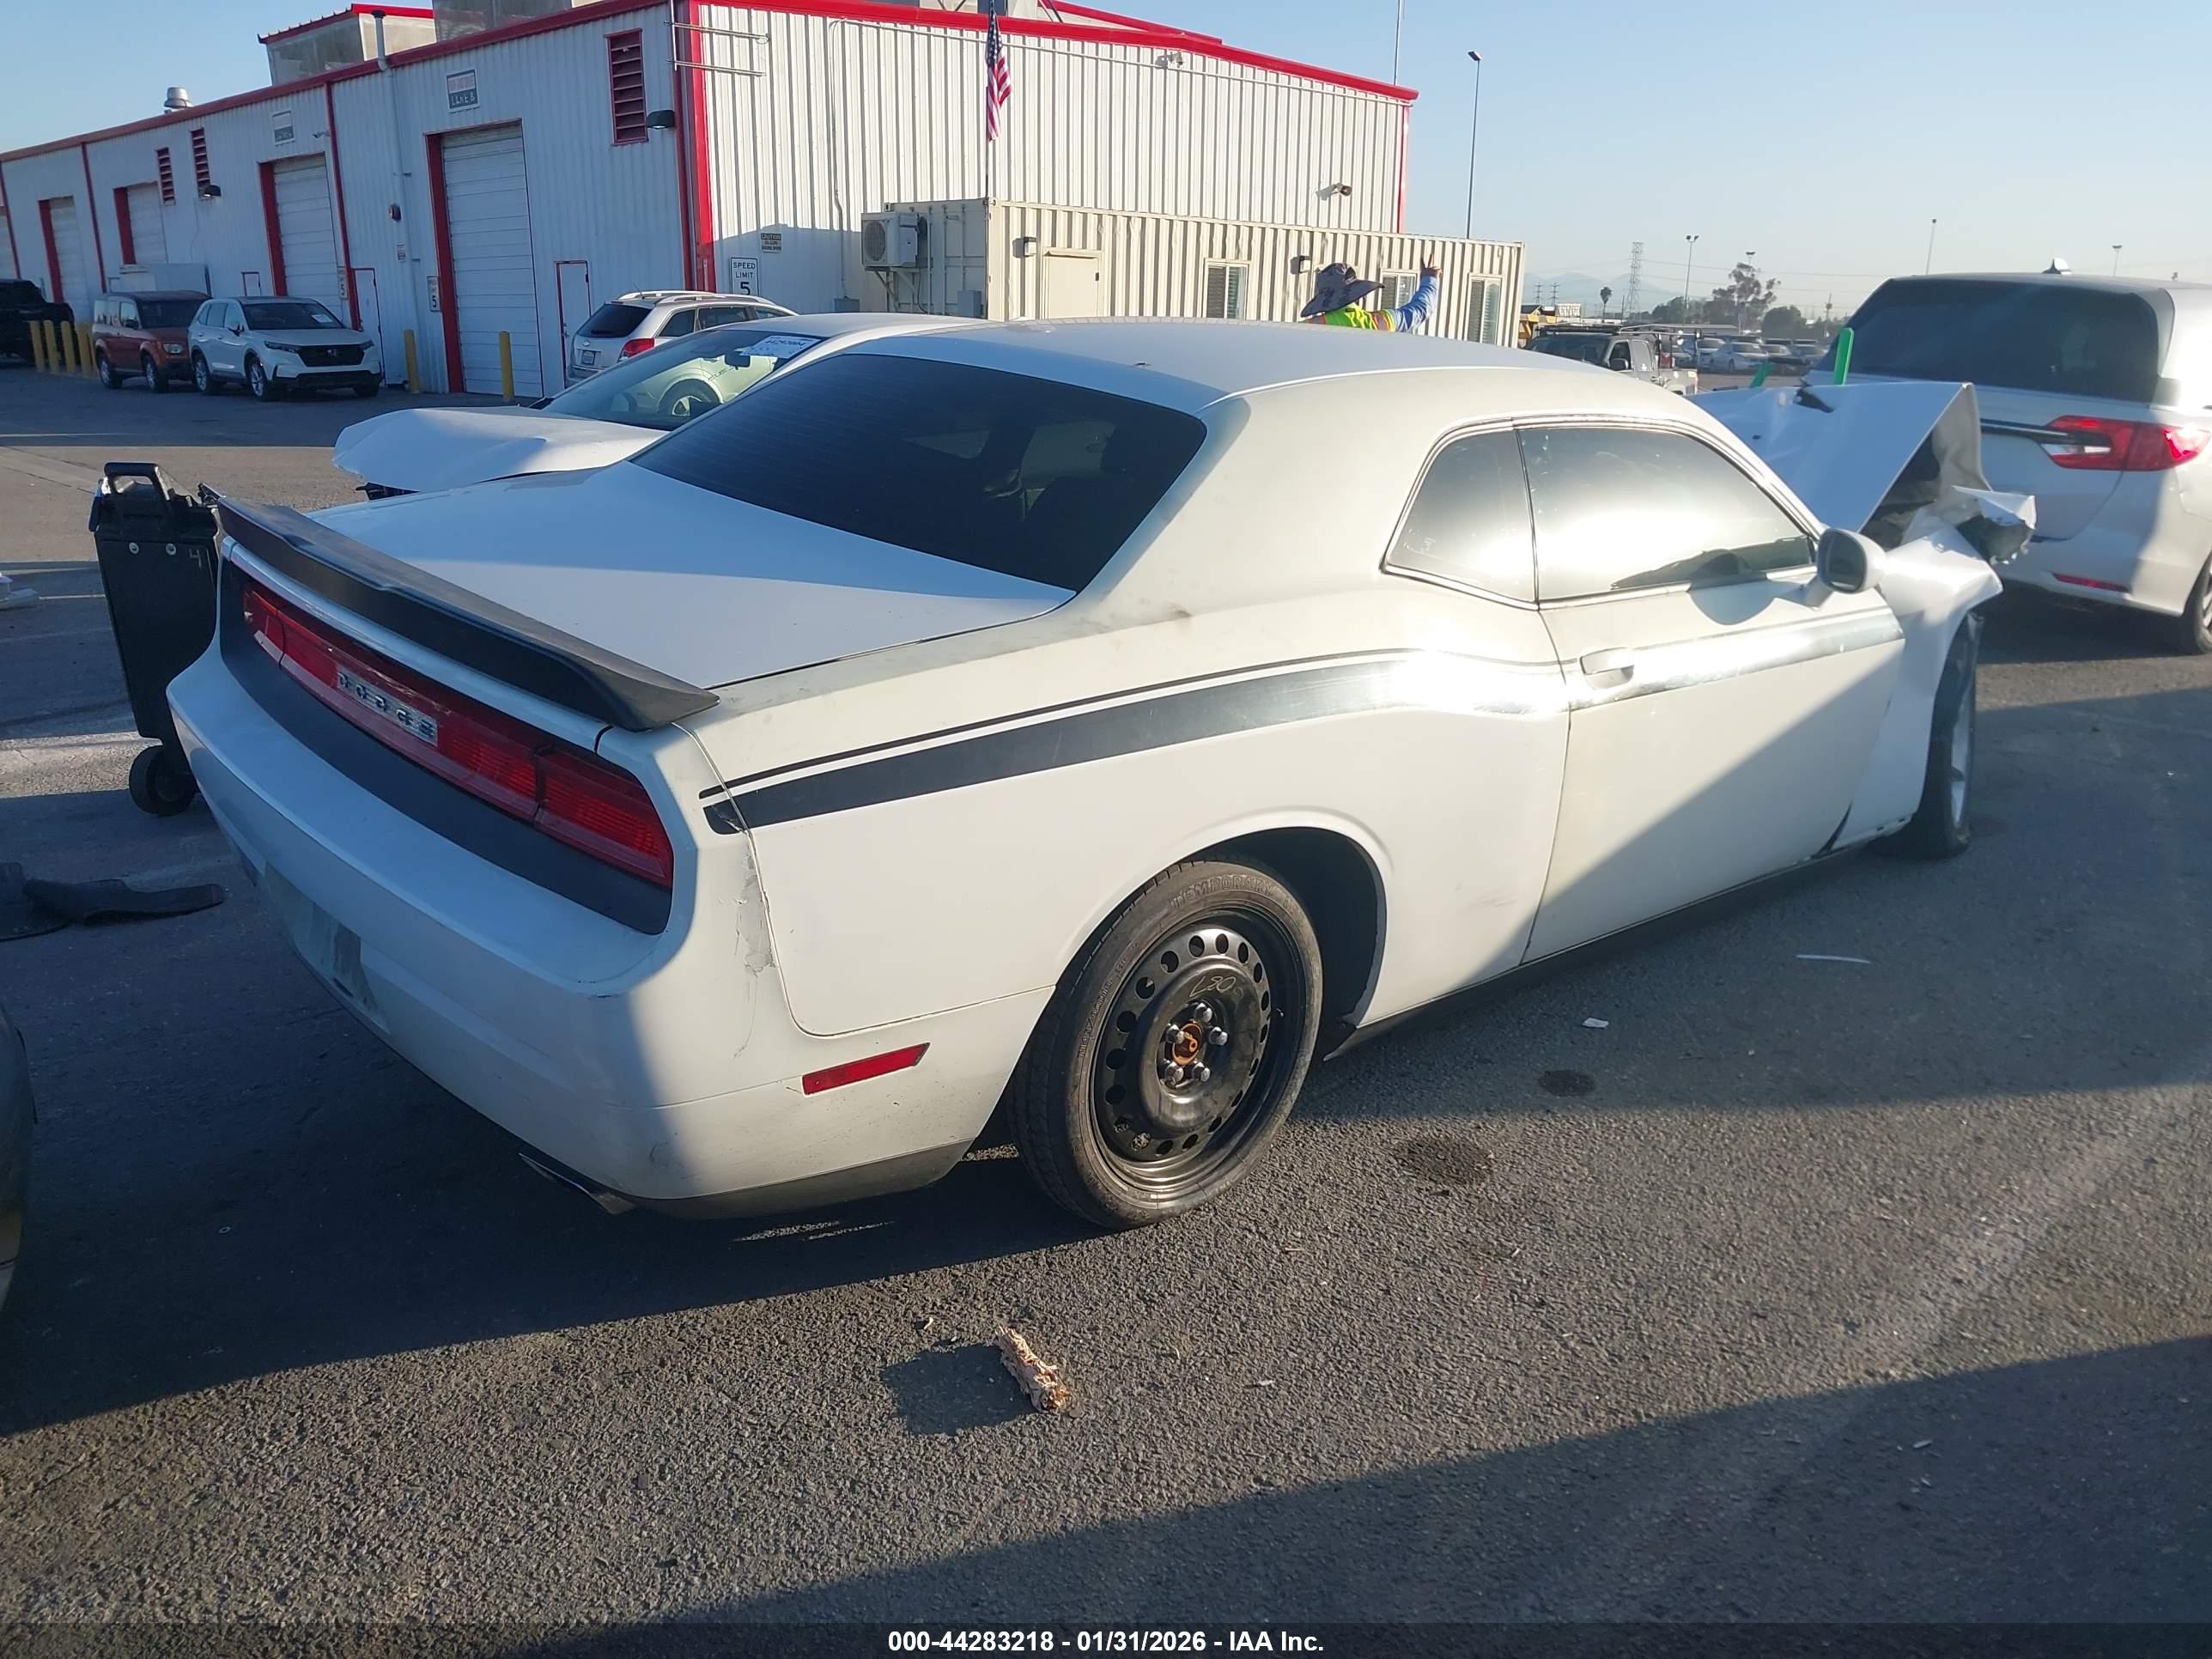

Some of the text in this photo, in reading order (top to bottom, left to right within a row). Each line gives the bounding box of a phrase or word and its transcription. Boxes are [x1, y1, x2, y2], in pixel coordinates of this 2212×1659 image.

[740, 282, 750, 295] 5
[432, 295, 437, 308] 5
[189, 549, 202, 568] 4
[1169, 874, 1273, 908] TEMPORARY
